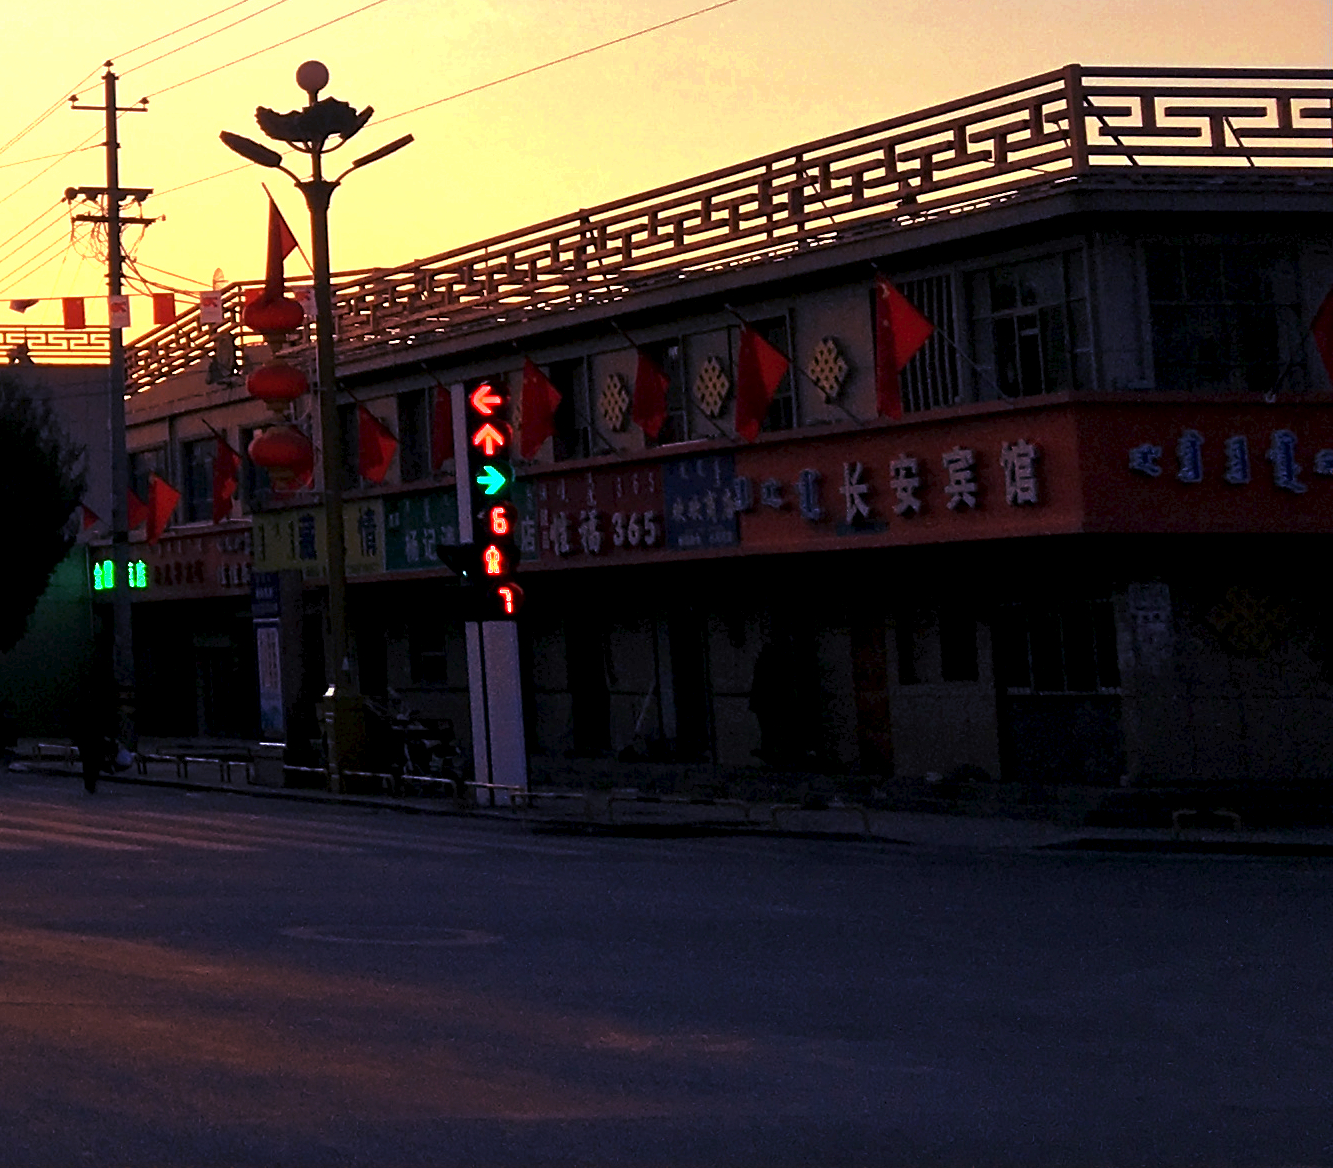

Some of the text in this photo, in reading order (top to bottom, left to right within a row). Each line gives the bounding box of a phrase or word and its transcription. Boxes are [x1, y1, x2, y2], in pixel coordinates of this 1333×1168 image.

[839, 438, 1039, 525] 长安宾馆
[490, 507, 509, 534] 6
[499, 586, 514, 614] 7
